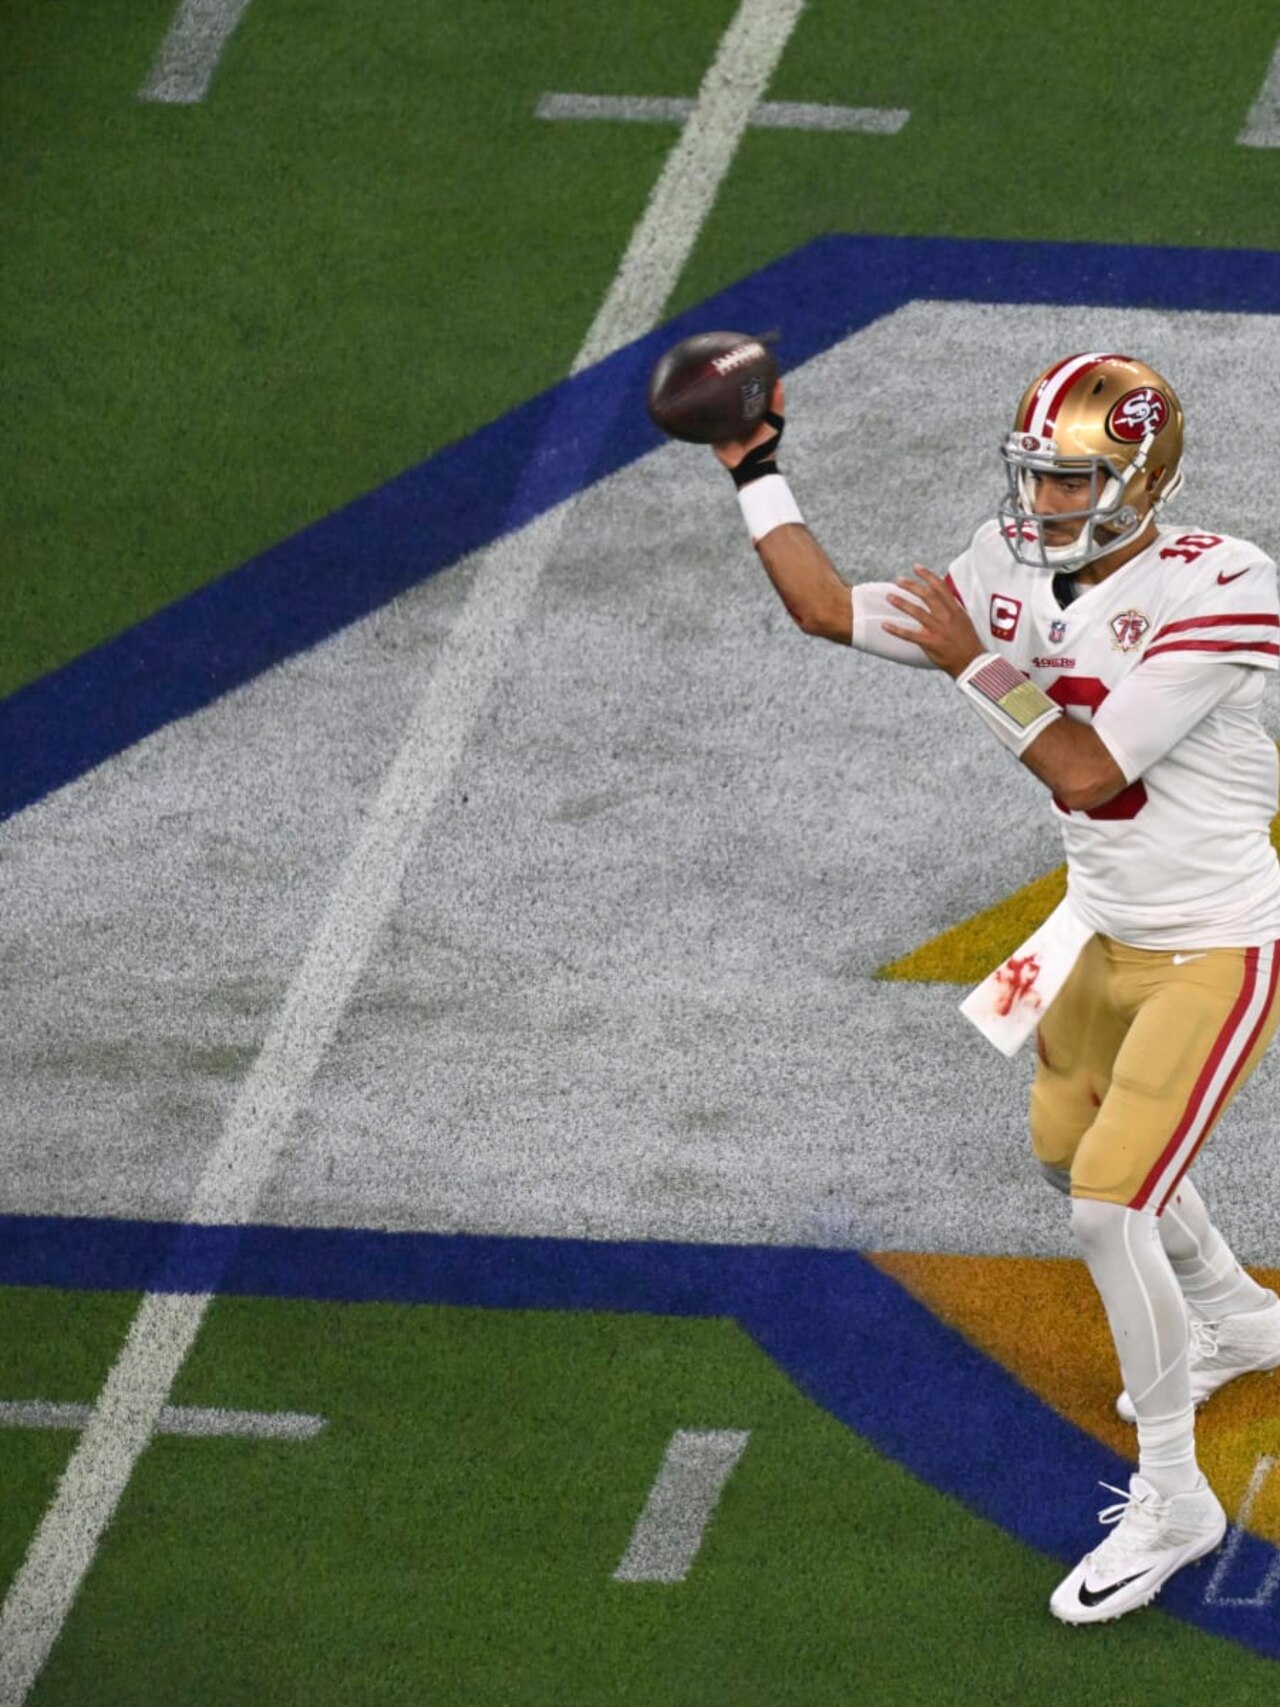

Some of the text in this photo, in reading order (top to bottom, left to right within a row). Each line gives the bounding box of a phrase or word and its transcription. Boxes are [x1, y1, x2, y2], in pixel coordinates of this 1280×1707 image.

[1160, 535, 1222, 563] 10
[992, 597, 1018, 630] C
[1118, 619, 1142, 643] 75
